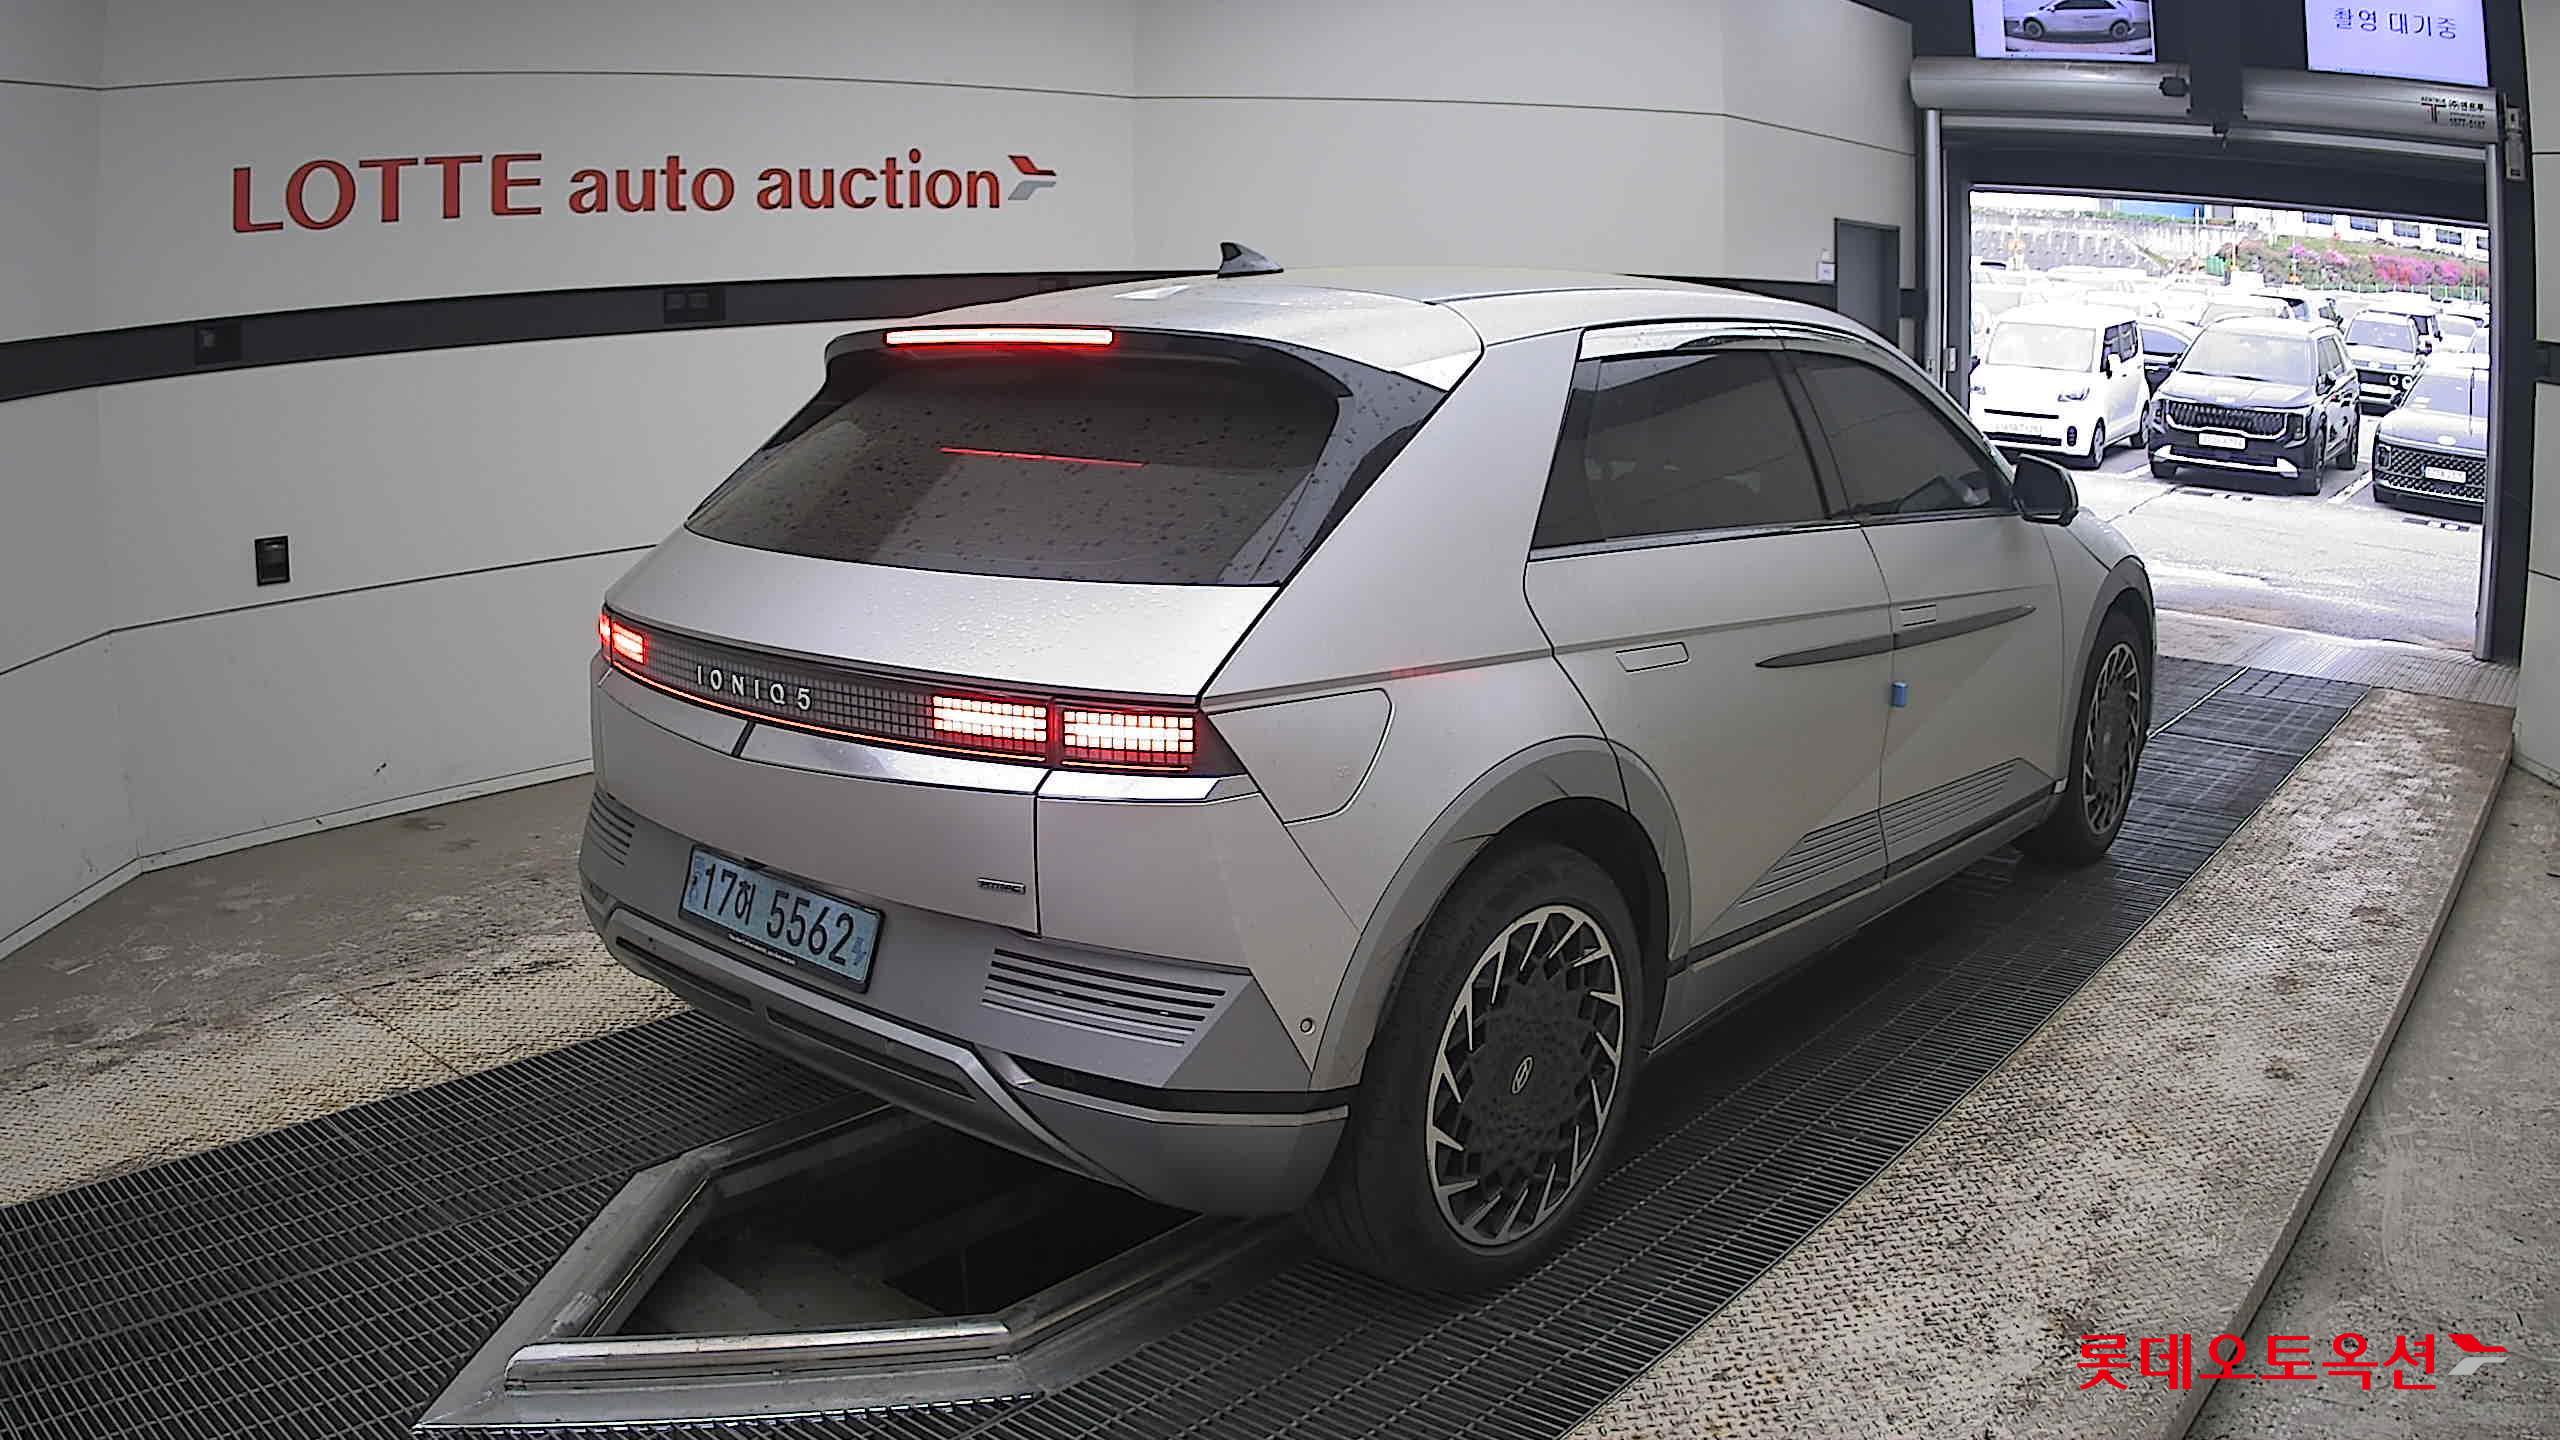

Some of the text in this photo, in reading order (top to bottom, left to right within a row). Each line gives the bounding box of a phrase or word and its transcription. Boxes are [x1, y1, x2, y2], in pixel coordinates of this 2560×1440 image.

[2389, 12, 2457, 40] 대기중
[233, 147, 1001, 233] LOTTE auto auction
[696, 664, 811, 711] IONIQ 5
[704, 863, 856, 966] 17허 5562
